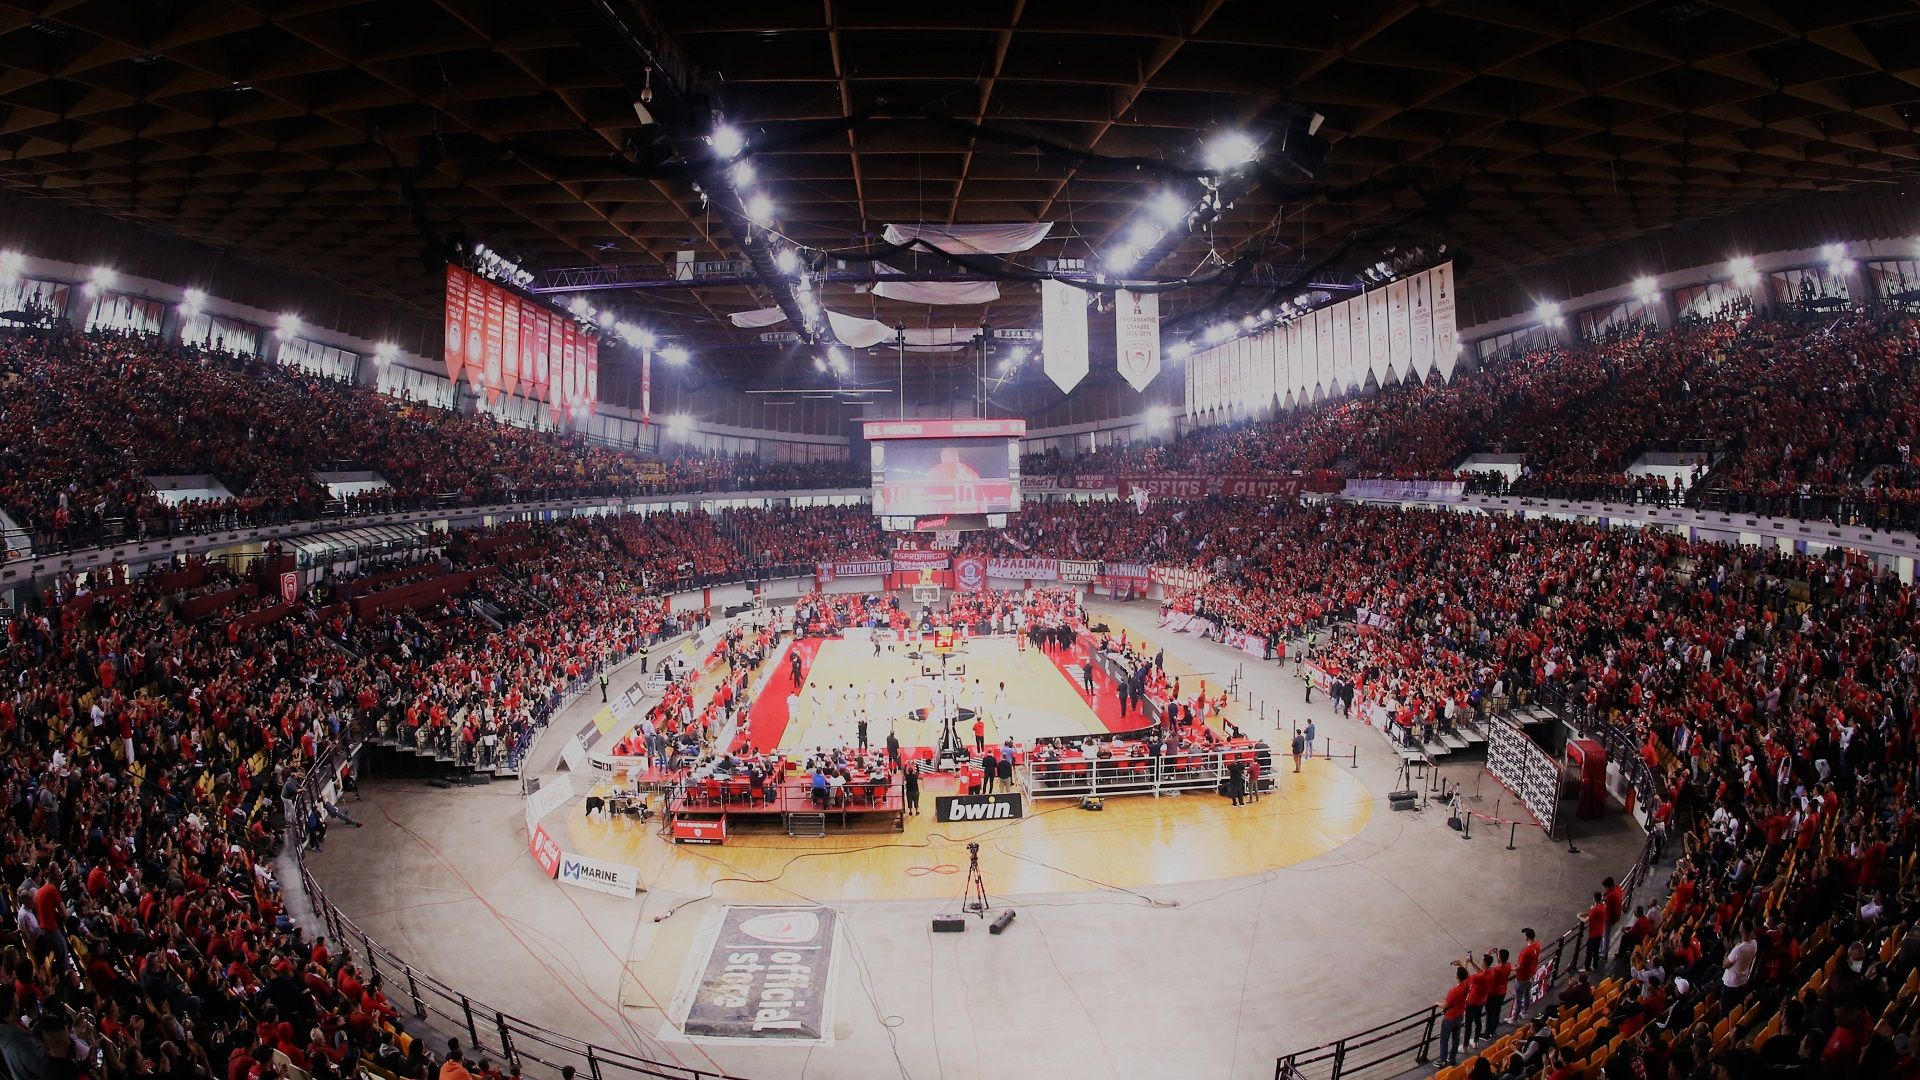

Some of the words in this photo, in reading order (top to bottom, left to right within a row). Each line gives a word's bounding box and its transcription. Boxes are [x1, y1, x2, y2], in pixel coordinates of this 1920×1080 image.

[1234, 481, 1296, 496] GATE-7
[835, 562, 892, 574] ΧΑΤΖΗΚΥΡΙΑΚΕΙΟ
[581, 865, 617, 882] MARINE
[712, 952, 765, 1008] store
[752, 952, 812, 1031] official
